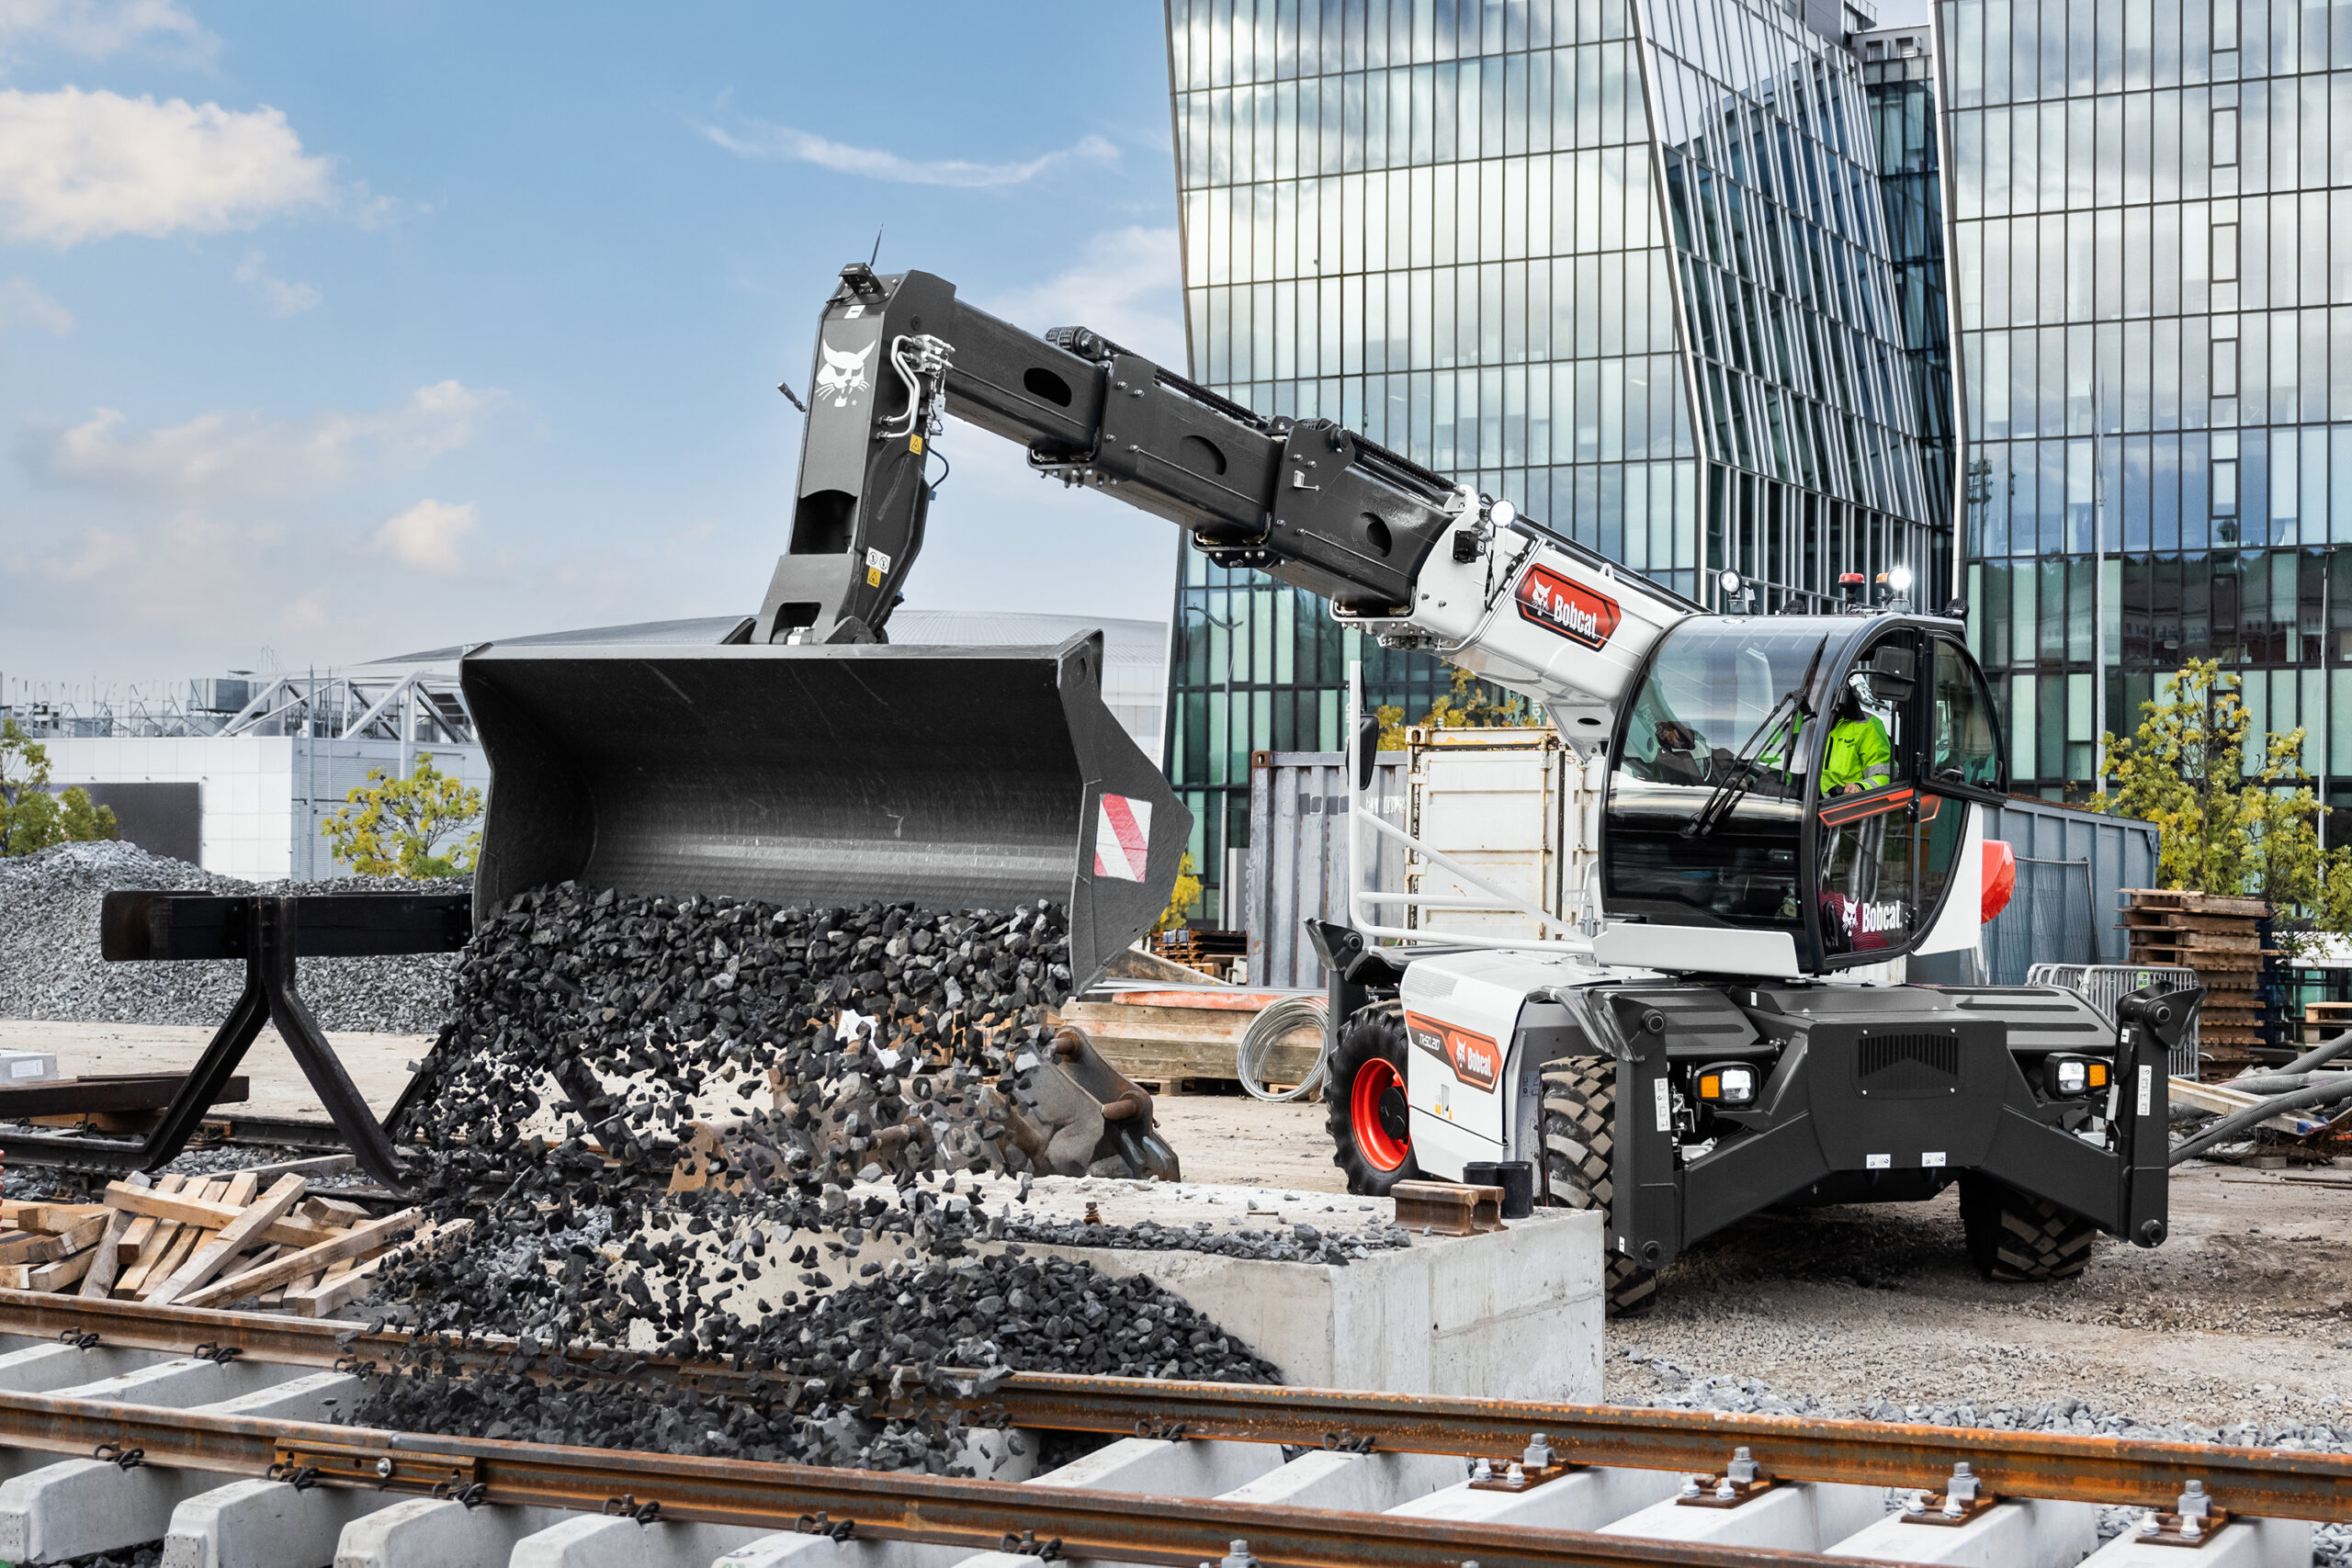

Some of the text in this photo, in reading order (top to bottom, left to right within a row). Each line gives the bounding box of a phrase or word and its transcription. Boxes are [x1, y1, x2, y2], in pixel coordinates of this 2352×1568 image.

[1554, 593, 1598, 639] Bobcat
[1862, 899, 1901, 933] Bobcat
[1467, 1046, 1492, 1077] Bobcat
